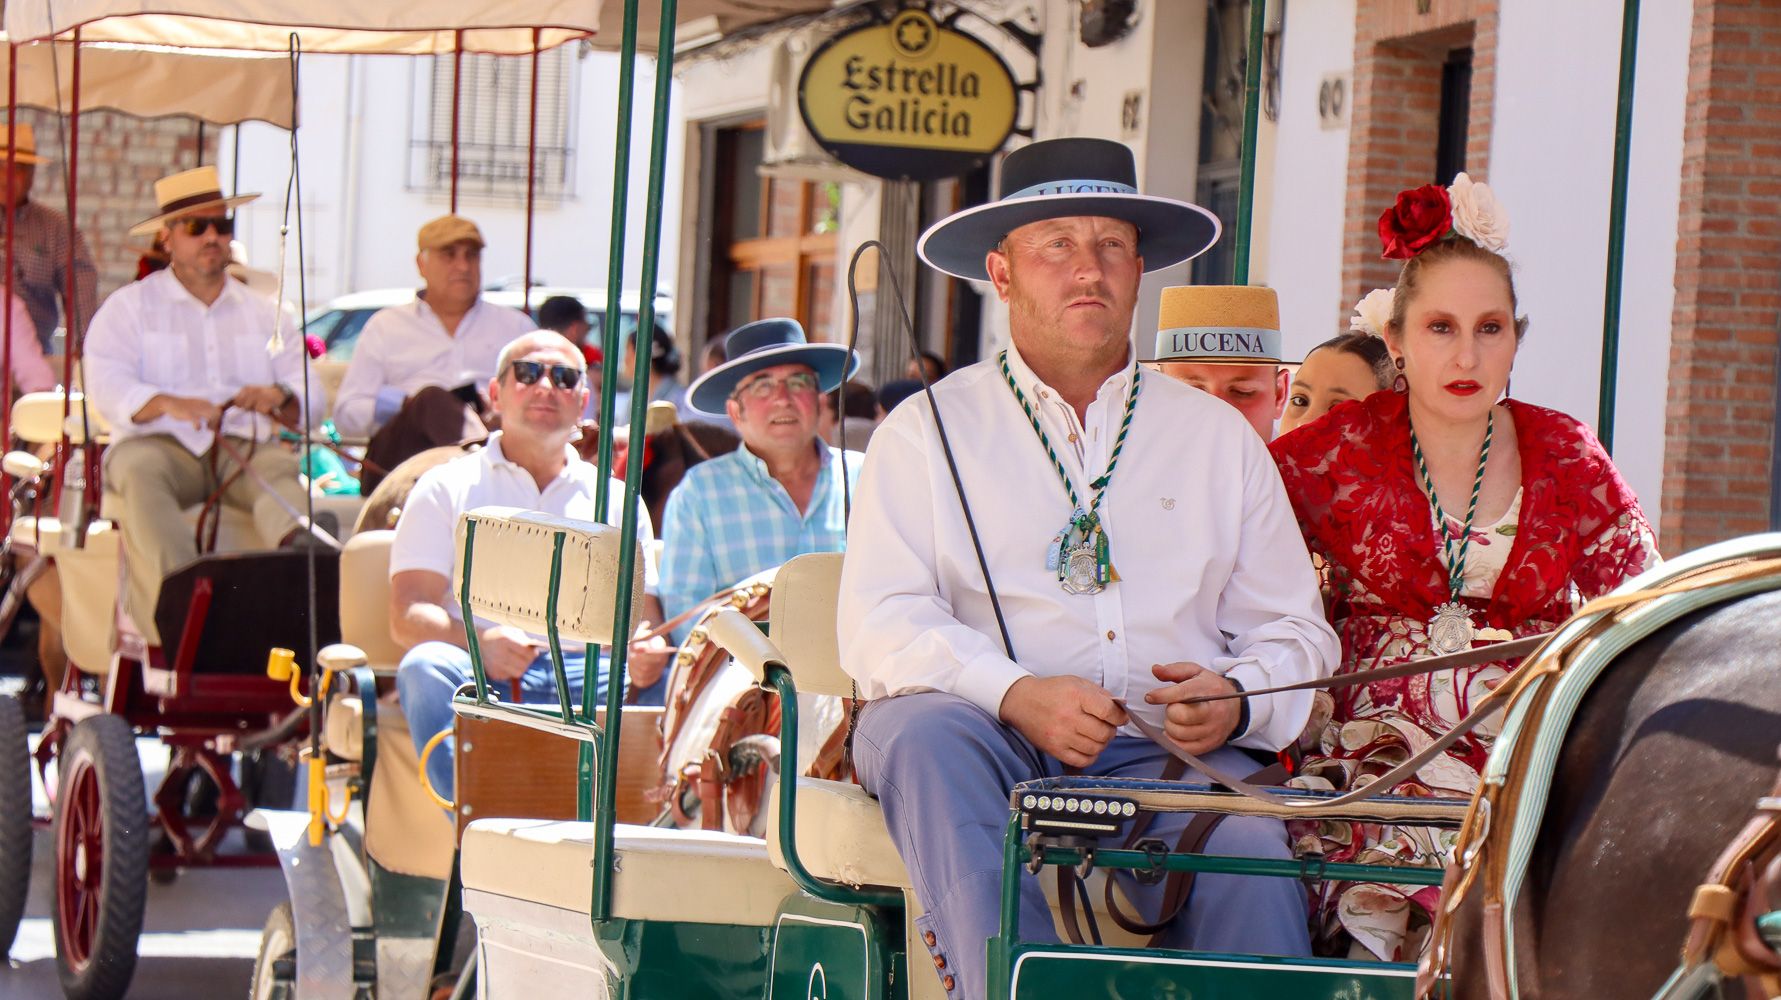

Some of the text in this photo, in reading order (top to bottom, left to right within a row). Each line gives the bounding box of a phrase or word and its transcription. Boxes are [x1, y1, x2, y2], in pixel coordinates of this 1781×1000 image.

[841, 54, 980, 98] Estrella
[845, 94, 971, 137] Galicia
[1172, 332, 1264, 353] LUCENA
